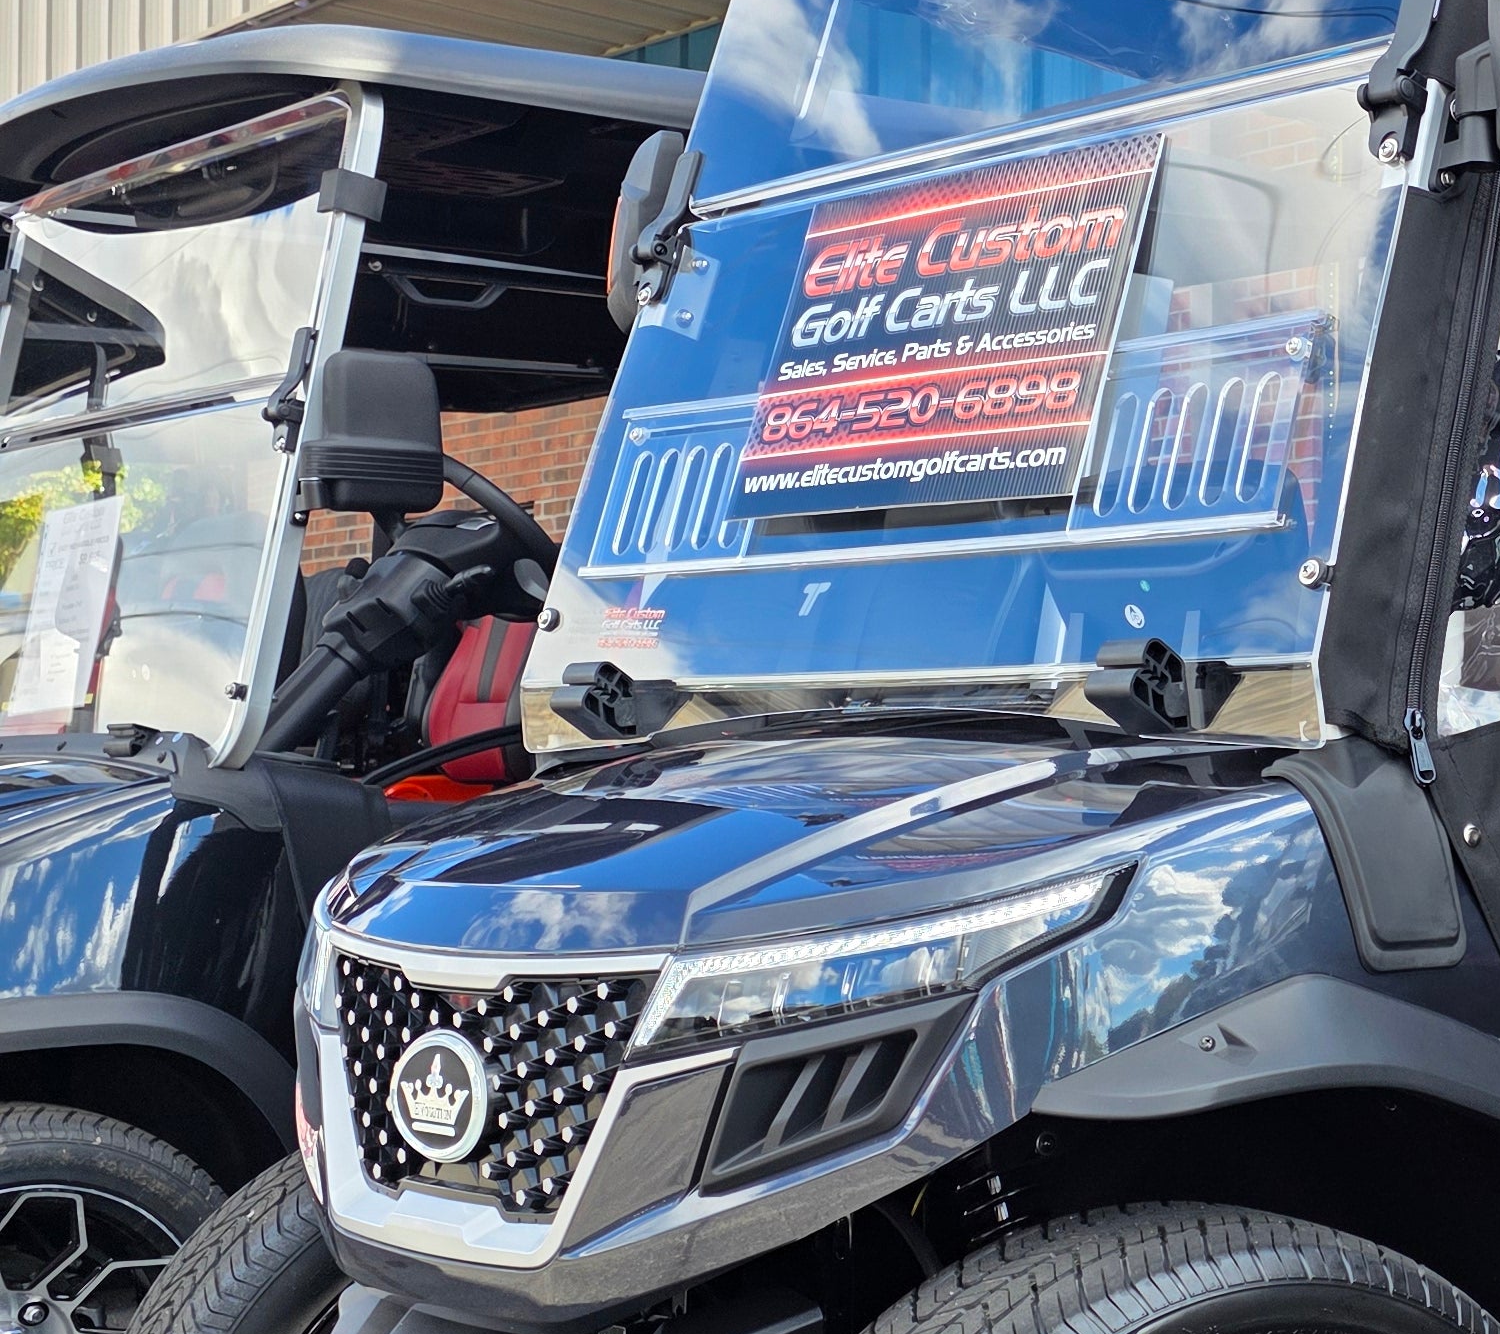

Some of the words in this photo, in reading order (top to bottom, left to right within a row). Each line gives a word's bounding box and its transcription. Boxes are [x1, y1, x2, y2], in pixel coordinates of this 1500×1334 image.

[804, 234, 908, 299] Elite
[917, 204, 1127, 276] Custom
[791, 292, 884, 349] Golf
[885, 277, 1002, 335] Carts
[1009, 258, 1111, 317] LLC
[778, 359, 828, 382] Sales,
[832, 350, 897, 374] Service,
[902, 340, 951, 364] Parts
[956, 339, 975, 356] &
[977, 321, 1096, 354] Accessories
[760, 370, 1081, 445] 864-520-6898
[744, 445, 1067, 495] www.elitecustomgolfcarts.com
[627, 606, 666, 619] Custom
[643, 619, 662, 630] LLC
